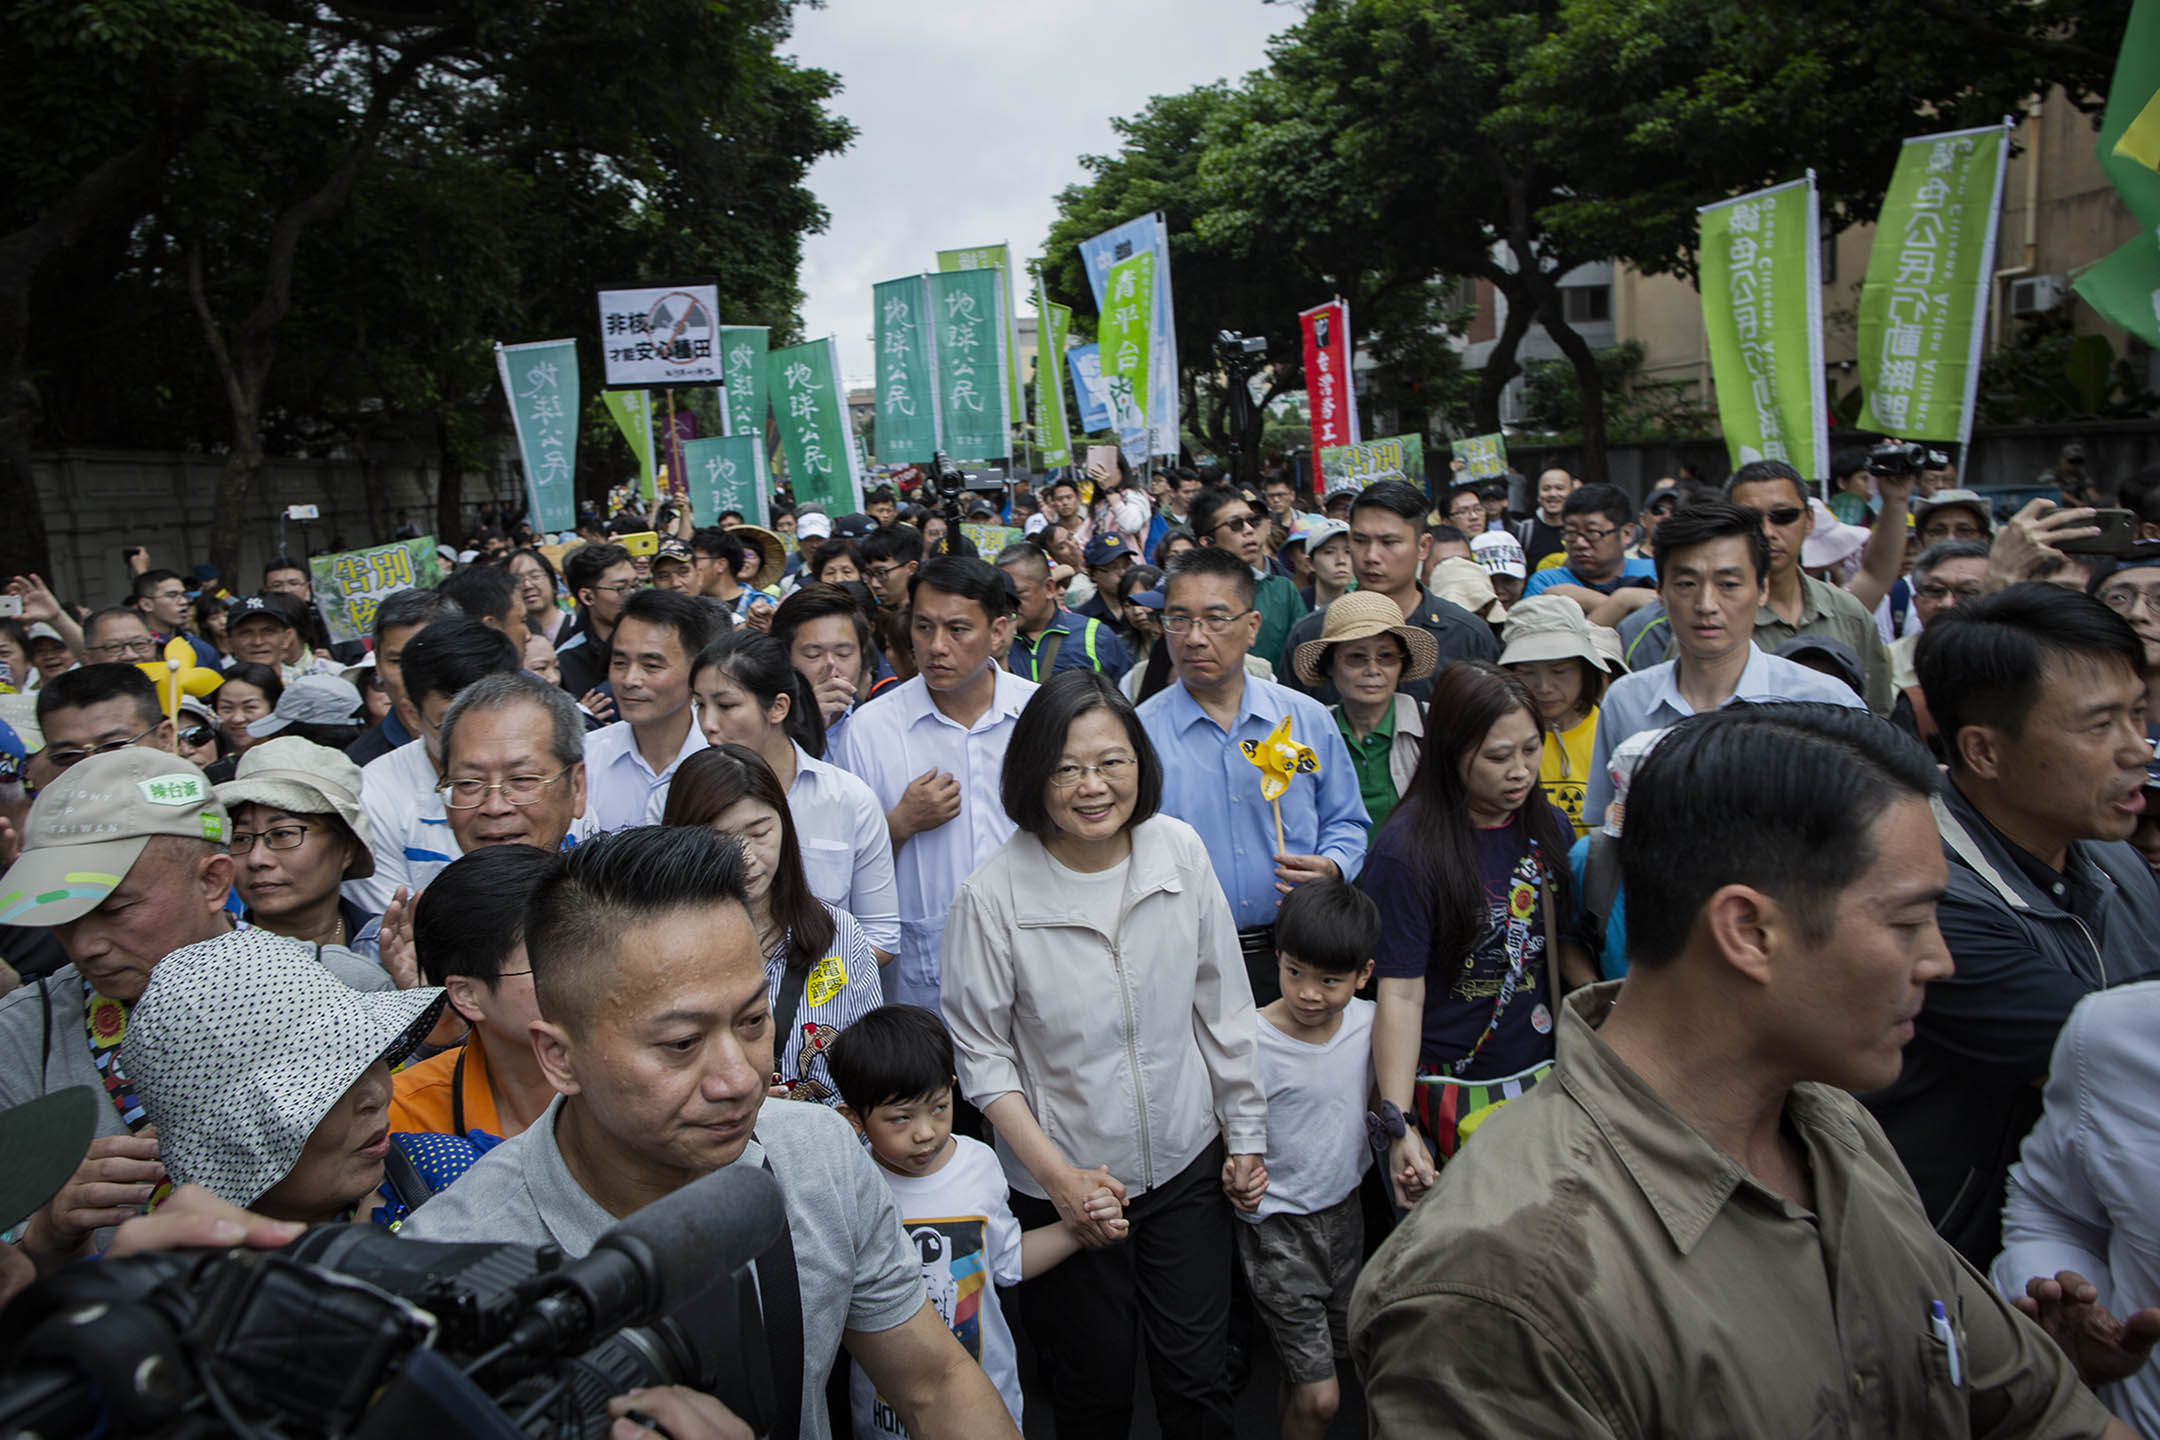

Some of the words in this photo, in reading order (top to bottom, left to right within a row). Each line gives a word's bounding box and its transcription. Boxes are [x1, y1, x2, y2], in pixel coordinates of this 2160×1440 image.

[883, 297, 917, 416] 地球公民
[944, 289, 984, 413] 地球公民
[1112, 269, 1139, 372] 青平台
[784, 361, 833, 475] 地球公民
[1343, 441, 1401, 477] 告別
[335, 548, 412, 595] 告別
[50, 822, 119, 834] TAIWAN
